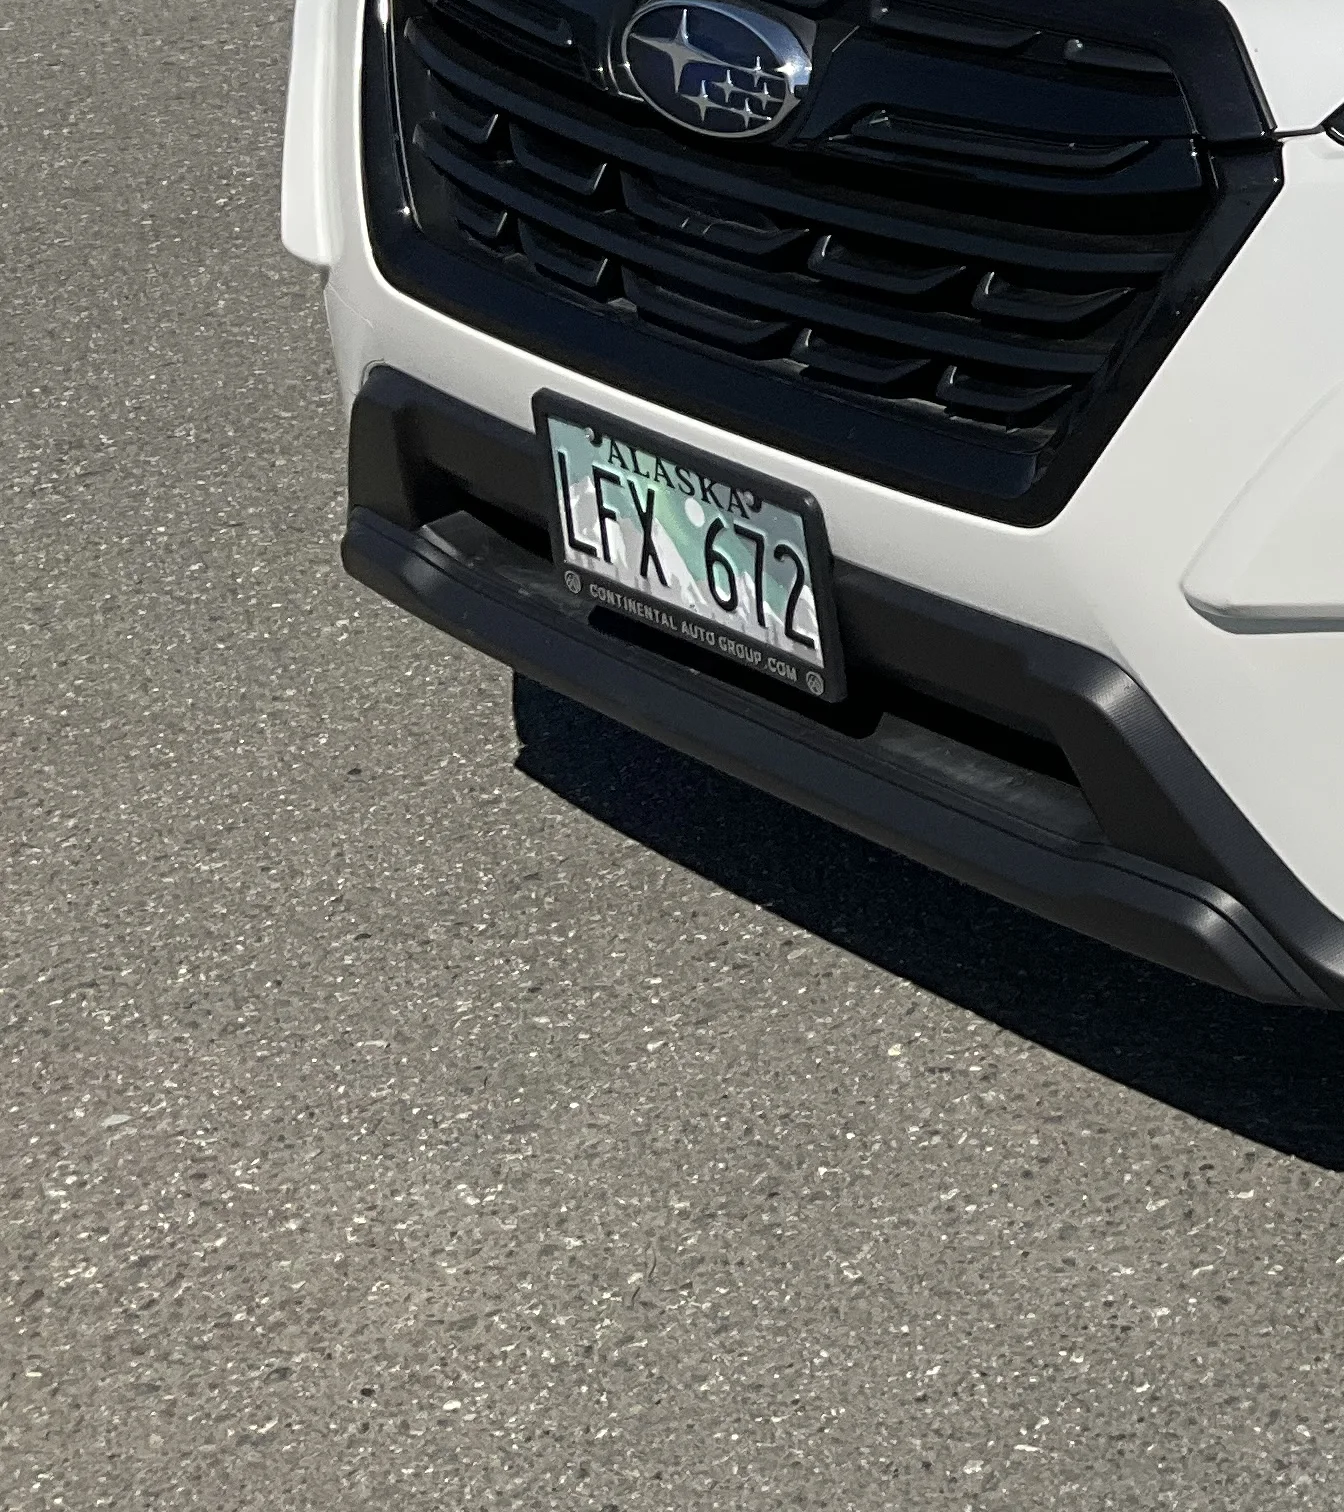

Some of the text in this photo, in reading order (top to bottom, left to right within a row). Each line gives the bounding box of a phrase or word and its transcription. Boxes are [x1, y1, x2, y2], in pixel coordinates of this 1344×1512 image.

[607, 438, 749, 519] ALASKA
[557, 450, 816, 650] LFX 672
[589, 583, 678, 631] CONTINENTAL
[681, 620, 716, 647] AUTO
[718, 635, 763, 666] GROUP
